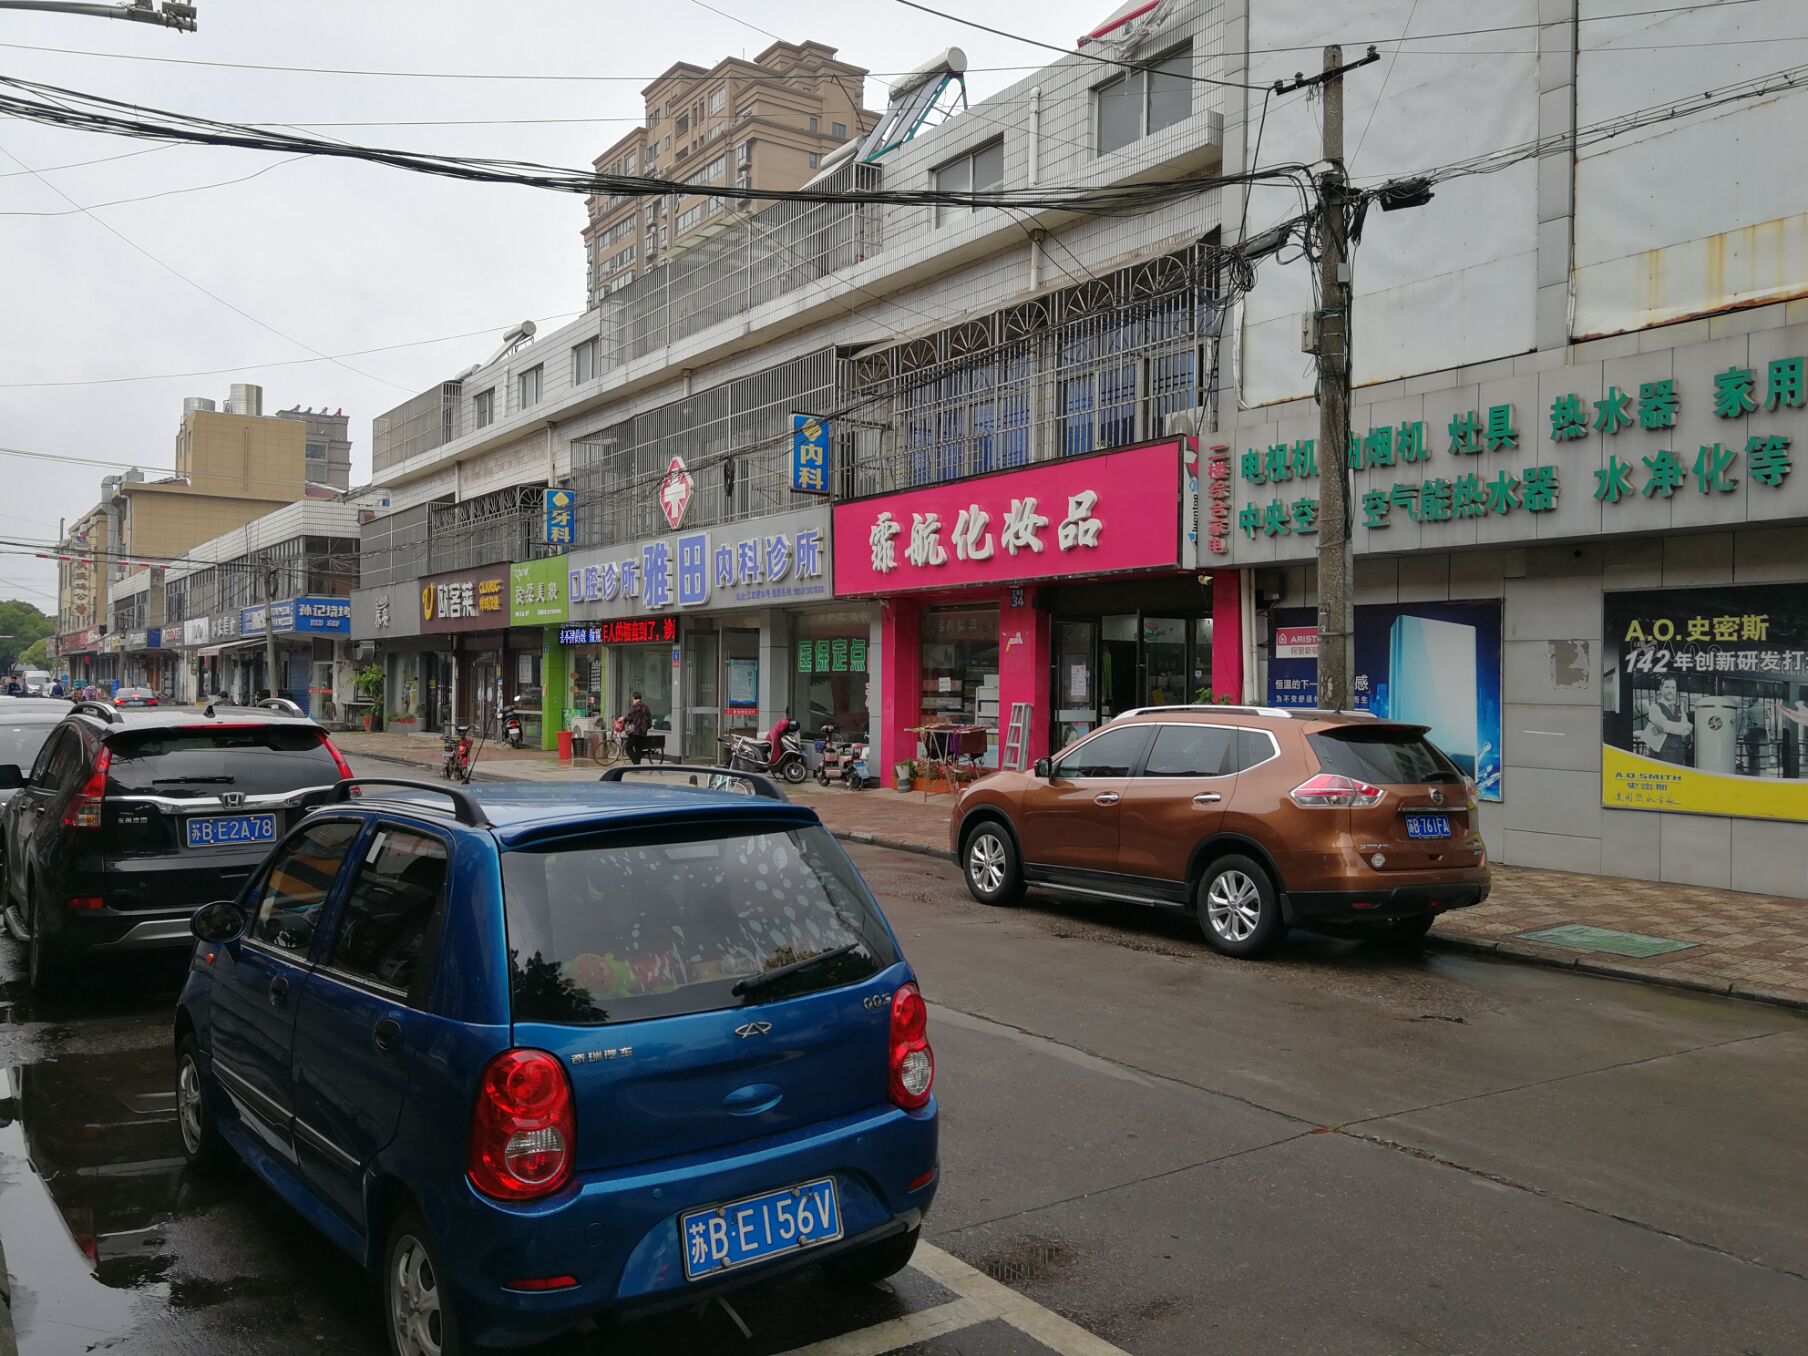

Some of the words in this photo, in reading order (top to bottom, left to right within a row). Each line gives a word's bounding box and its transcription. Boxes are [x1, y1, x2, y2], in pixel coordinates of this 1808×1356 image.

[1241, 439, 1319, 485] 电视机
[1448, 403, 1518, 455] 灶具
[1550, 378, 1680, 443] 热水器
[1713, 356, 1808, 419] 家用
[798, 444, 824, 489] 内科
[1362, 465, 1560, 528] 空气能热水器
[1593, 435, 1793, 504] 水净化等
[1207, 445, 1232, 554] 二楼综合家电
[551, 509, 571, 543] 牙科
[869, 489, 1102, 573] 霏航化妆品
[569, 558, 640, 604] 口腔诊所
[642, 532, 714, 609] 雅田
[714, 527, 824, 588] 内科诊所
[798, 639, 866, 673] 医保定点
[1625, 649, 1808, 673] 142年创新研发打
[1354, 674, 1369, 691] 感
[191, 821, 272, 841] 苏B·E2A78
[863, 992, 891, 1010] QQ3
[571, 1046, 633, 1065] 奇瑞汽车
[689, 1188, 833, 1265] 苏B·E156V
